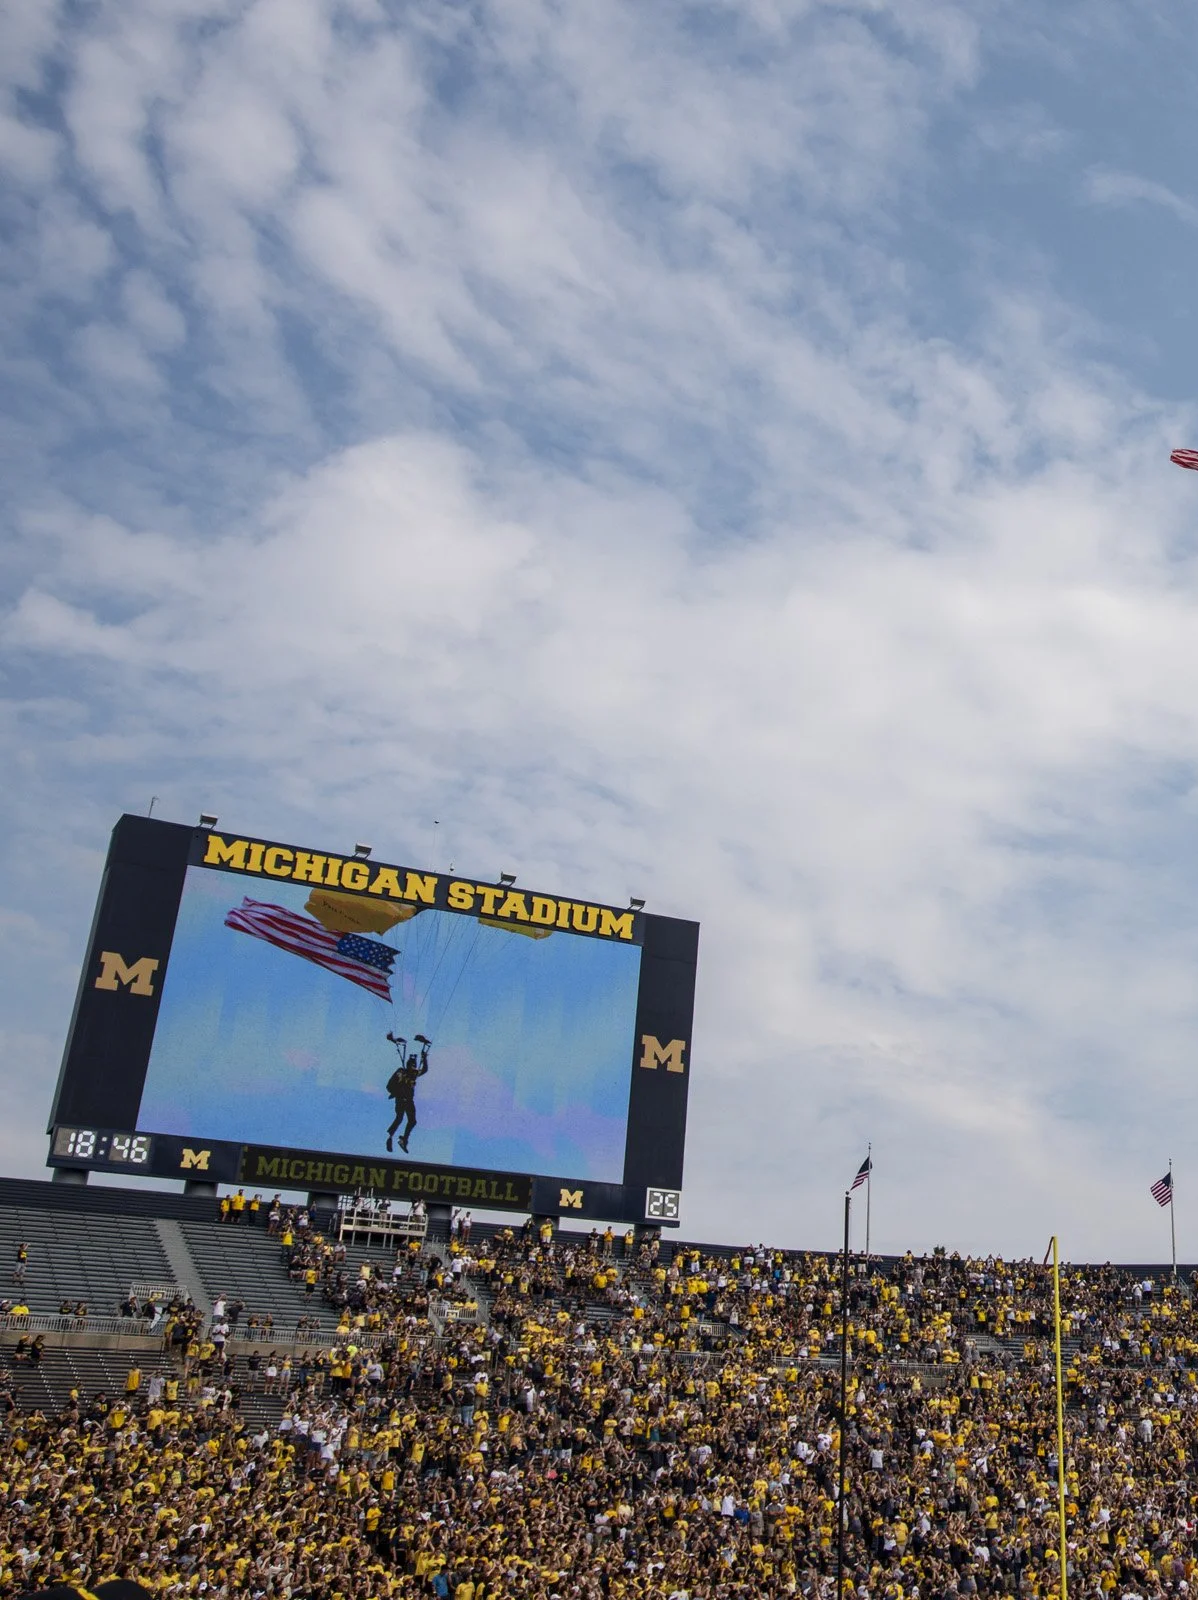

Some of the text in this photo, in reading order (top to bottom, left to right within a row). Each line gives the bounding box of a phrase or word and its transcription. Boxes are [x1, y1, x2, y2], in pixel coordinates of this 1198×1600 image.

[203, 834, 635, 940] MICHIGAN STADIUM
[94, 951, 159, 997] M
[640, 1034, 686, 1073] M
[67, 1130, 148, 1163] 18:46
[180, 1148, 211, 1171] M
[256, 1155, 519, 1202] MICHIGAN FOOTBALL
[559, 1188, 584, 1209] M
[649, 1191, 677, 1217] 25
